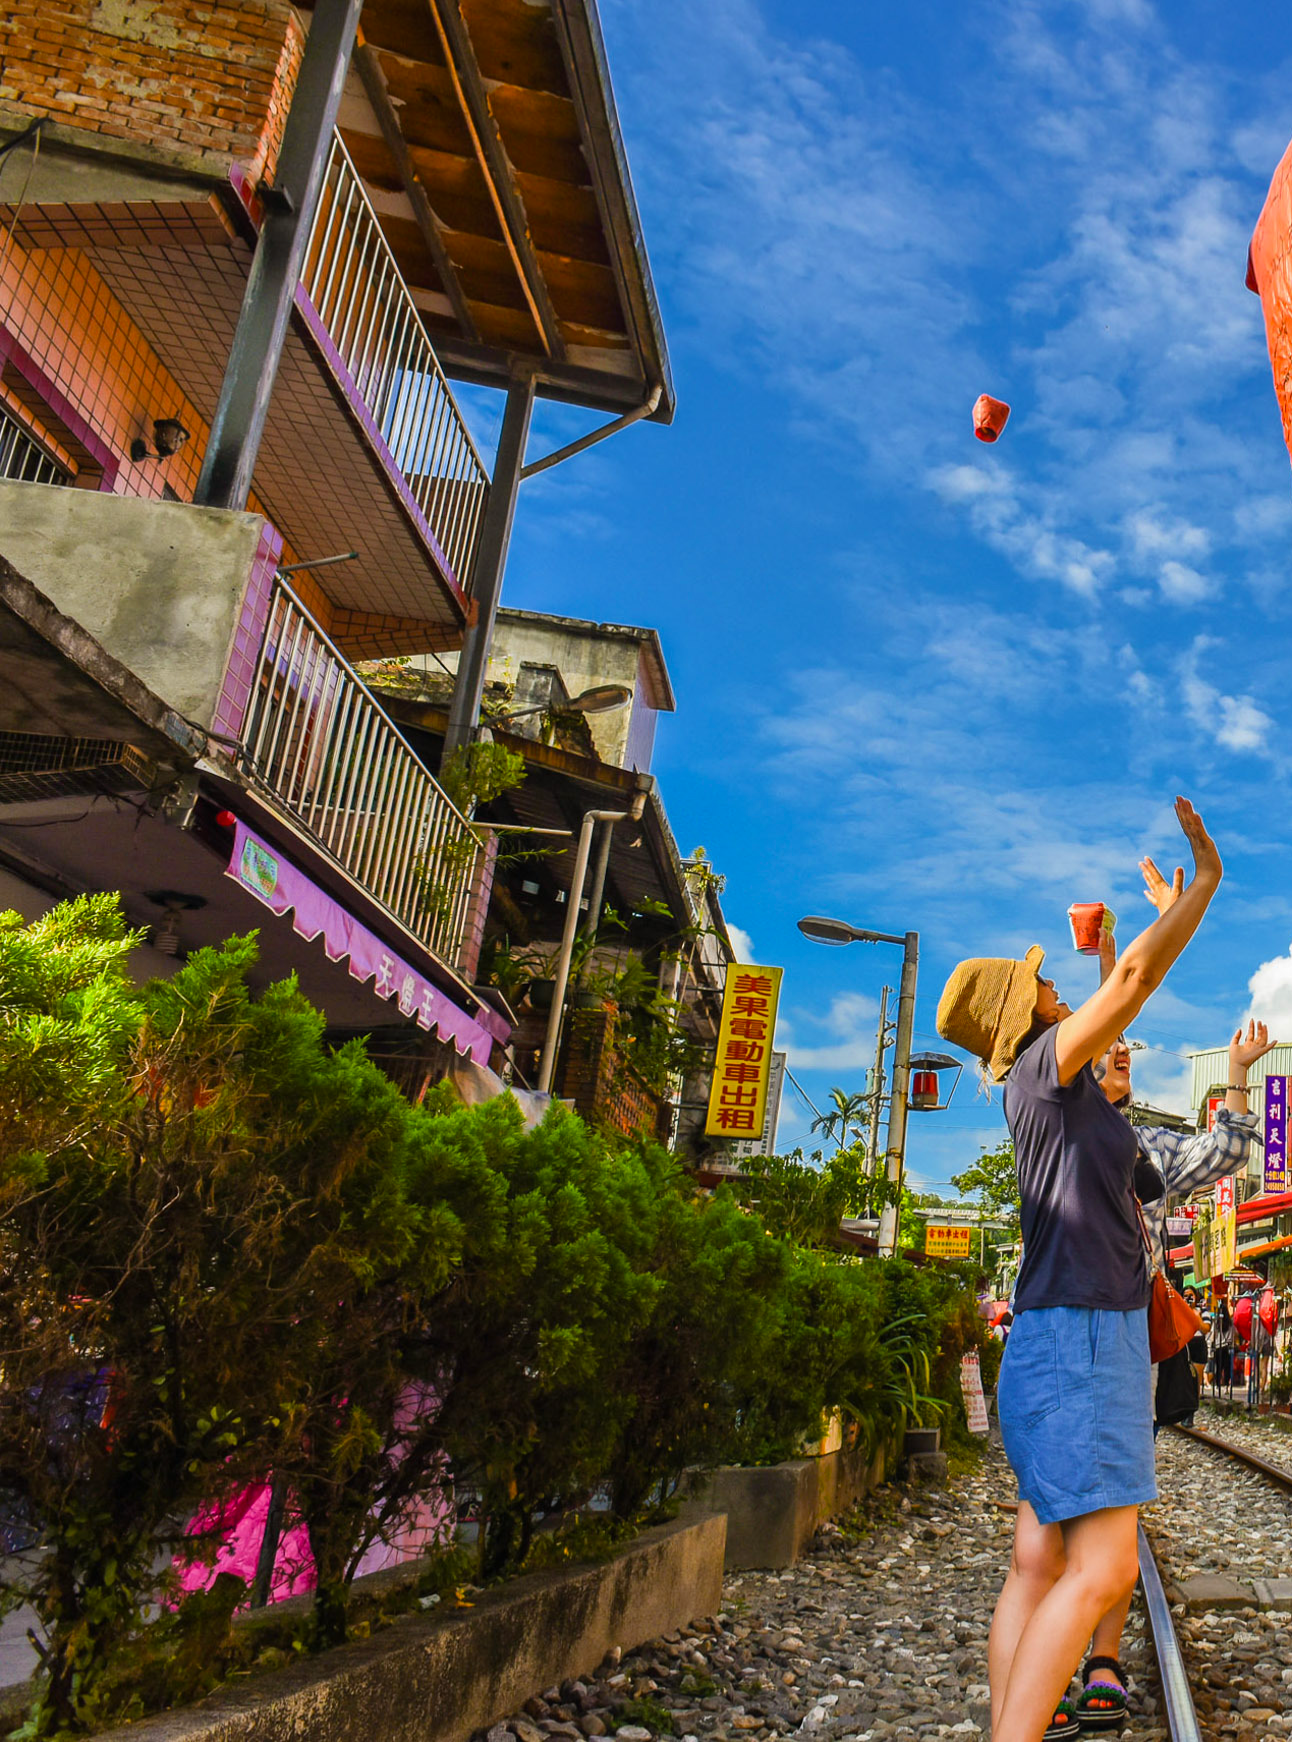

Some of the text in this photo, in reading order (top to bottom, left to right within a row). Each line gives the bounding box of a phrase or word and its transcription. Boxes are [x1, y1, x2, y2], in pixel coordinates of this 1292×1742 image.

[715, 974, 773, 1131] 美果電動車出租
[1268, 1079, 1283, 1169] 吉利天燈
